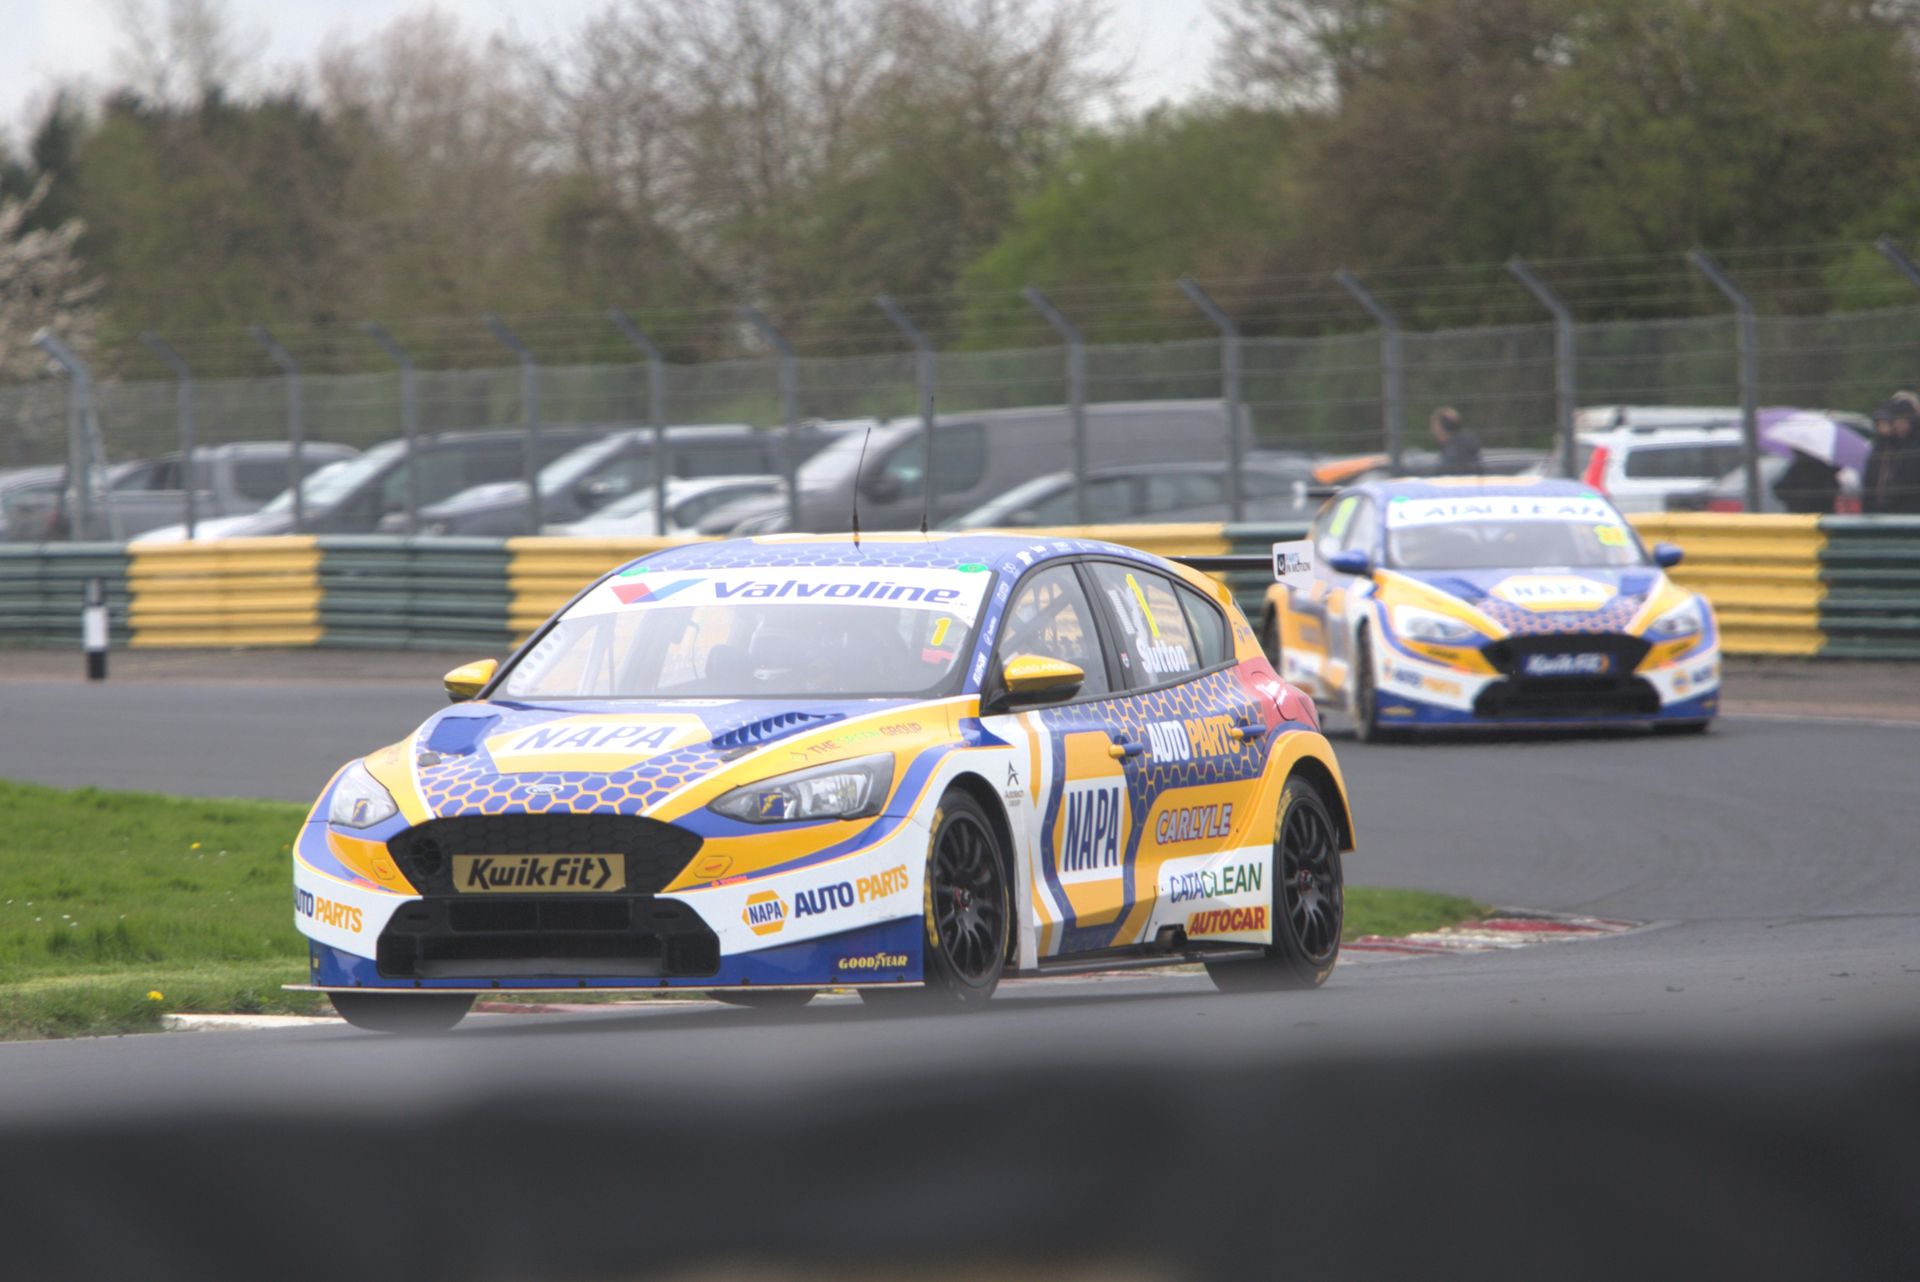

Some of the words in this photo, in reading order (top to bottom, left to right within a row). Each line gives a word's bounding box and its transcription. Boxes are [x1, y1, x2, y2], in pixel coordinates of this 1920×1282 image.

[714, 580, 961, 604] Valvoline
[1126, 573, 1161, 638] 1
[930, 617, 952, 647] 1
[1136, 637, 1190, 674] Sutton
[513, 726, 678, 751] NAPA
[1145, 720, 1191, 764] AUTO
[1183, 715, 1241, 759] PARTS
[1064, 787, 1120, 872] NAPA
[1156, 803, 1233, 846] CARLYLE
[749, 900, 783, 925] NAPA
[794, 881, 855, 919] AUTO
[856, 864, 910, 904] PARTS
[1169, 862, 1263, 904] CATACLEAN
[295, 886, 314, 918] UTO
[315, 896, 363, 934] PARTS
[1188, 906, 1266, 936] AUTOCAR
[838, 952, 909, 970] GOODYEAR
